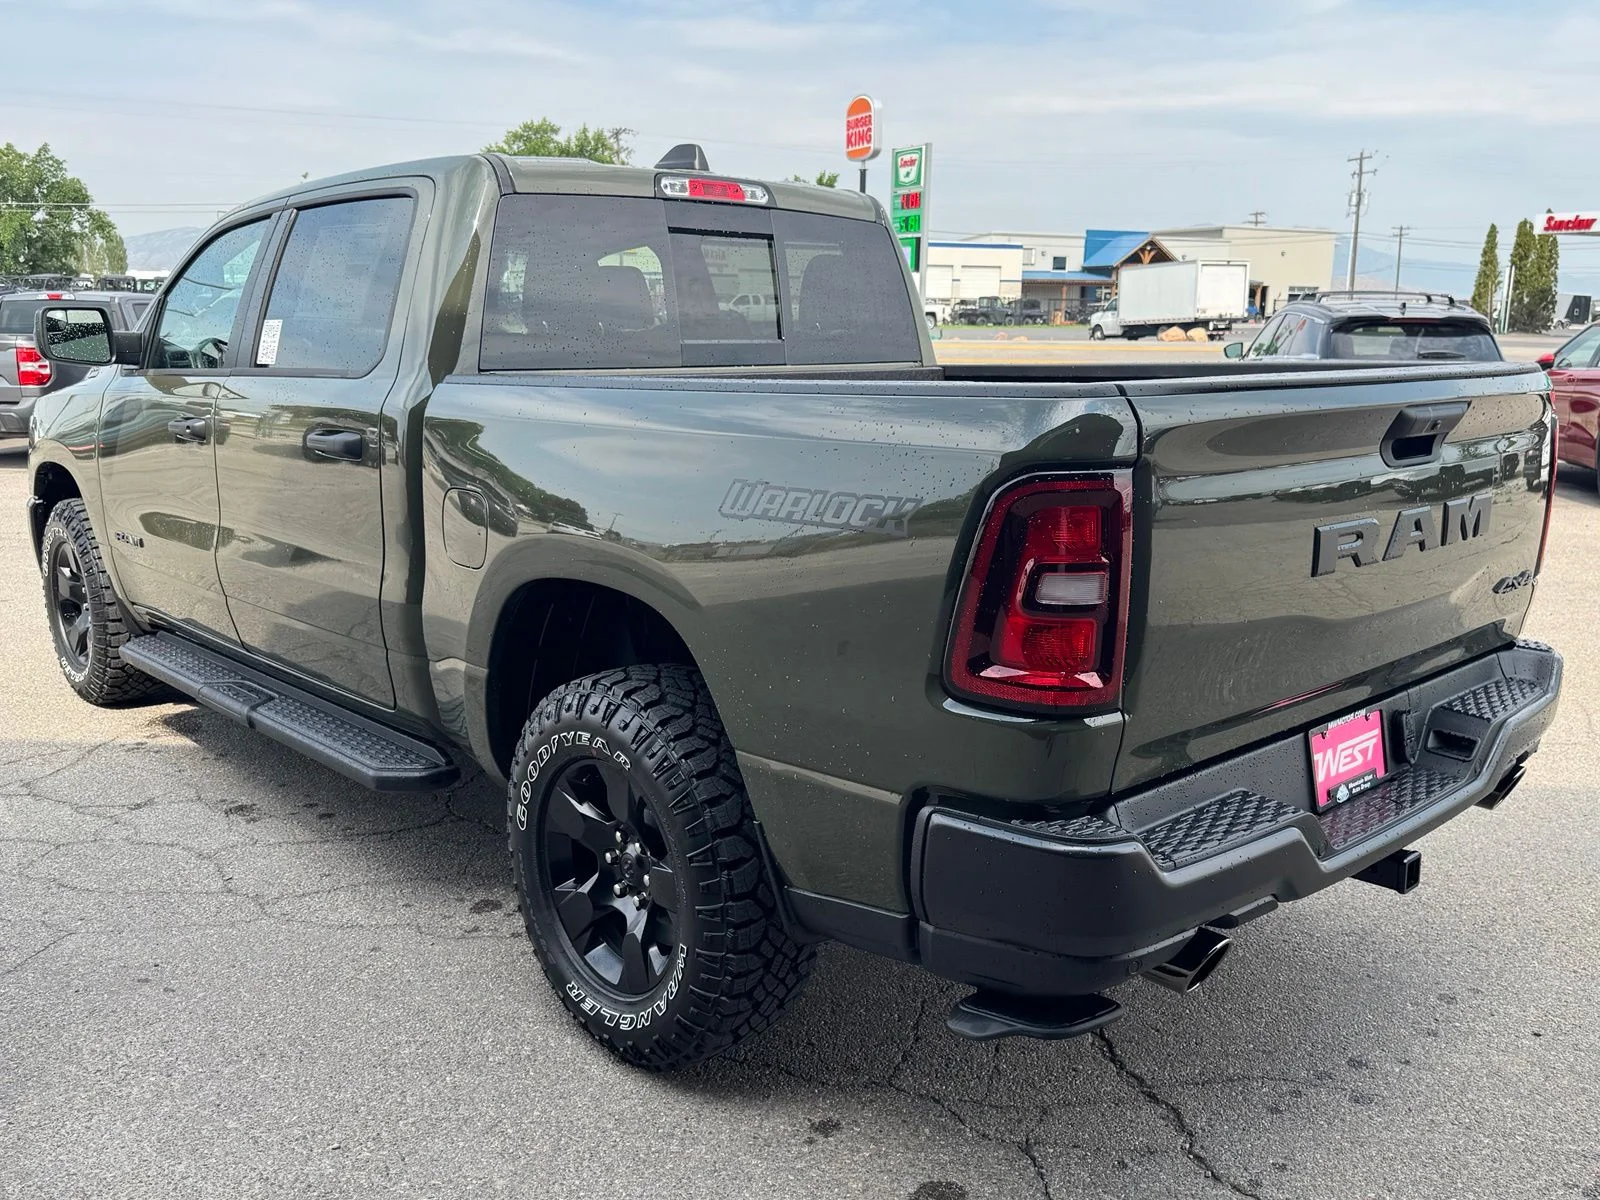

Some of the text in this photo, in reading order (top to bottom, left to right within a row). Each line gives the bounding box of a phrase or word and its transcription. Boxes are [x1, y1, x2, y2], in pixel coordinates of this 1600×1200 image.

[846, 114, 872, 131] BURGER
[846, 127, 872, 149] KING
[1543, 214, 1597, 232] Sinclair
[718, 479, 922, 536] WARLOCK
[1311, 493, 1492, 577] RAM
[515, 730, 633, 832] GOODYEAR
[1313, 728, 1379, 782] WEST
[565, 942, 688, 1031] WRANGLER
